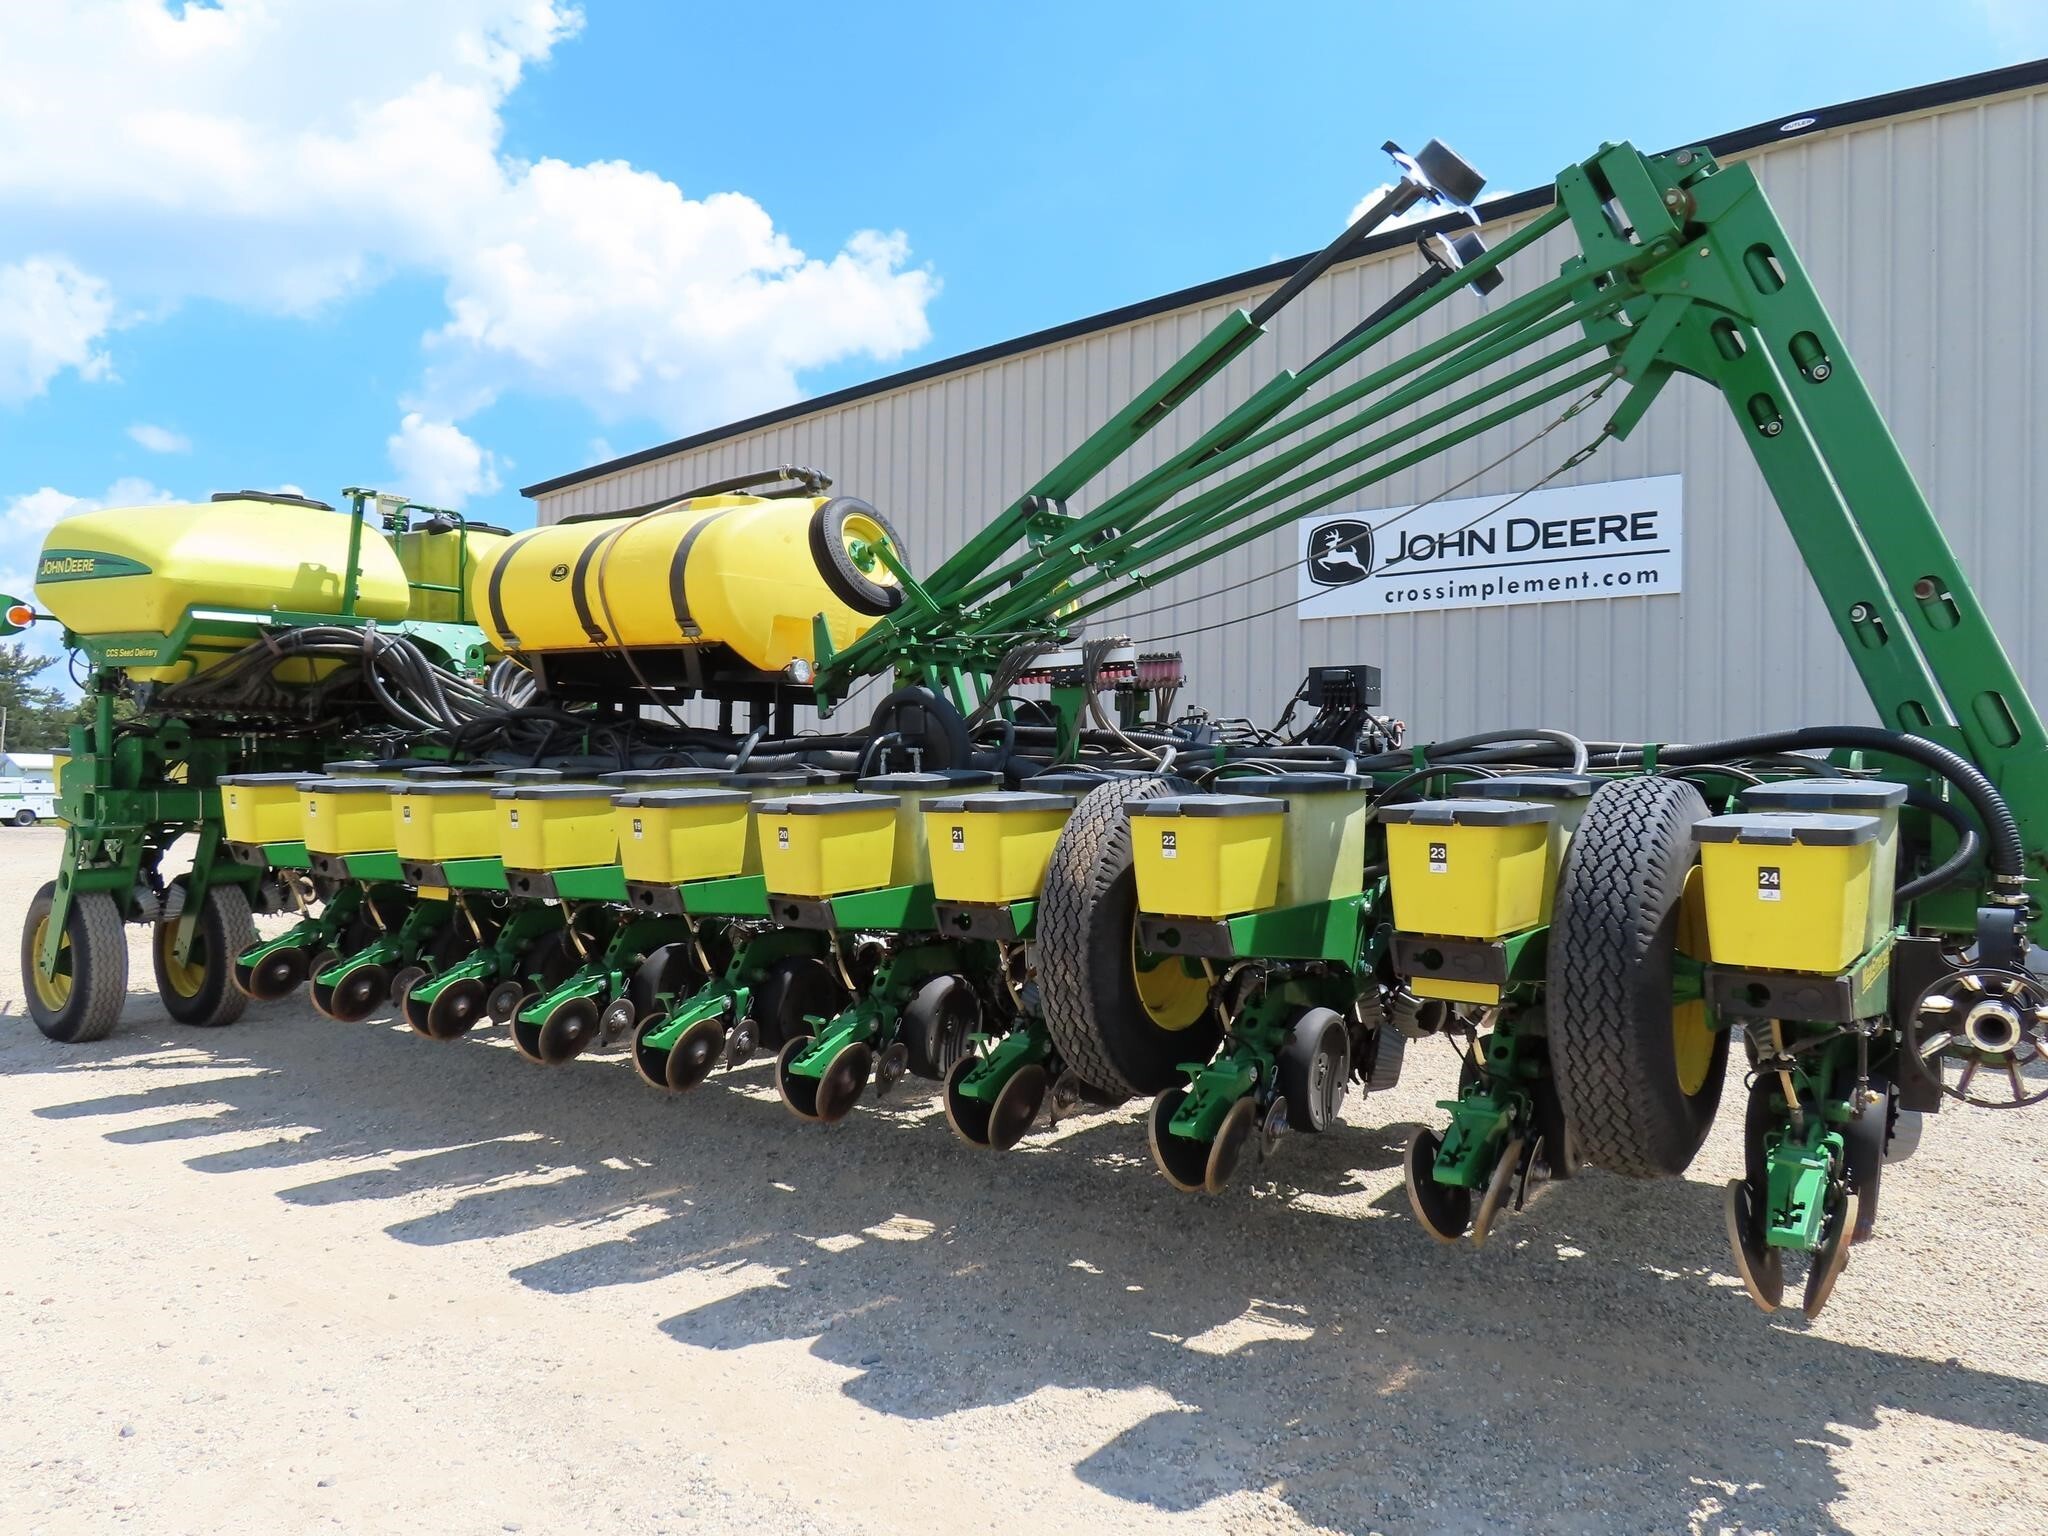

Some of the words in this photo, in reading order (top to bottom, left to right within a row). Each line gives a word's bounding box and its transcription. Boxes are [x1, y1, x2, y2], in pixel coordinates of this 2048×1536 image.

[1385, 527, 1496, 565] JOHN
[1506, 510, 1658, 553] DEERE
[41, 559, 64, 575] JOHN
[64, 557, 95, 573] DEERE
[1385, 568, 1660, 603] crossimplement.com
[106, 648, 119, 657] CCS
[119, 648, 134, 657] Seed
[135, 648, 158, 658] Delivery
[779, 830, 788, 839] 20
[952, 830, 962, 840] 21
[1163, 835, 1175, 846] 22
[1430, 847, 1445, 859] 23
[1760, 872, 1779, 885] 24
